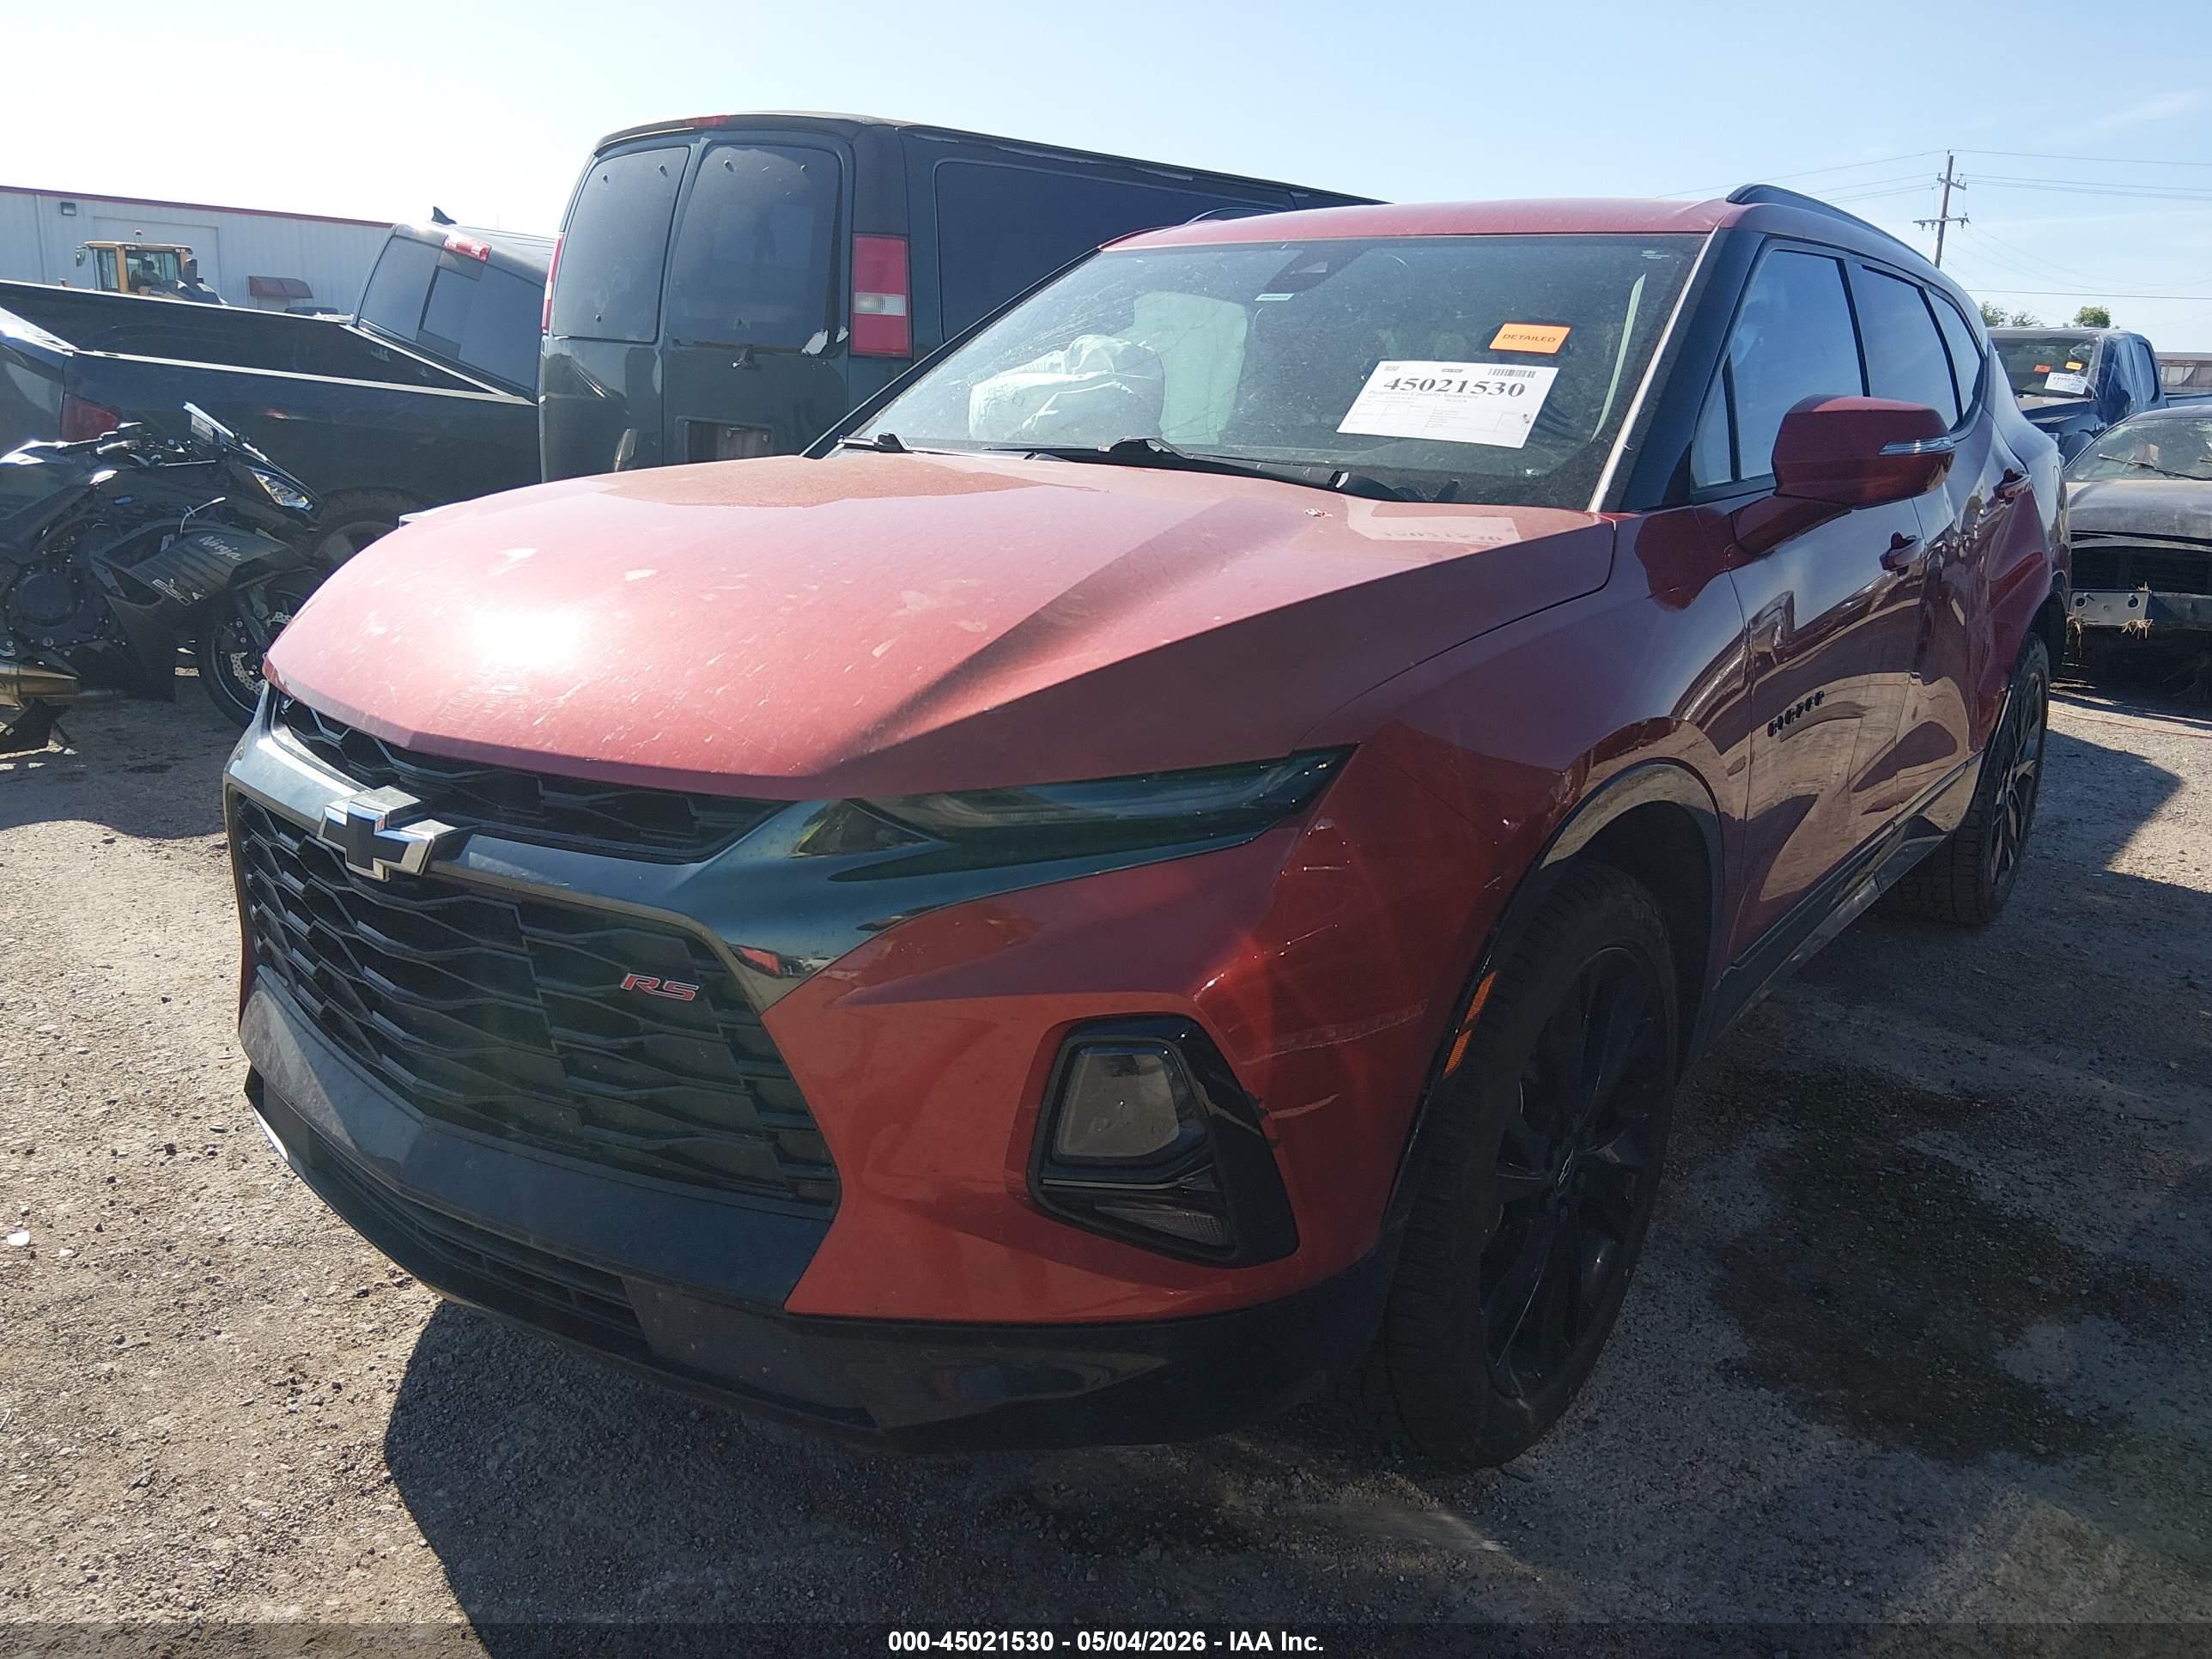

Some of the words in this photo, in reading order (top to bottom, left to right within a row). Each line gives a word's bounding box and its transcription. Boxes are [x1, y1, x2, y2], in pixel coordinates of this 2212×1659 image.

[1503, 334, 1557, 343] DETAILED
[1383, 377, 1526, 398] 45021530
[198, 535, 242, 561] Ninja
[620, 972, 700, 1001] RS
